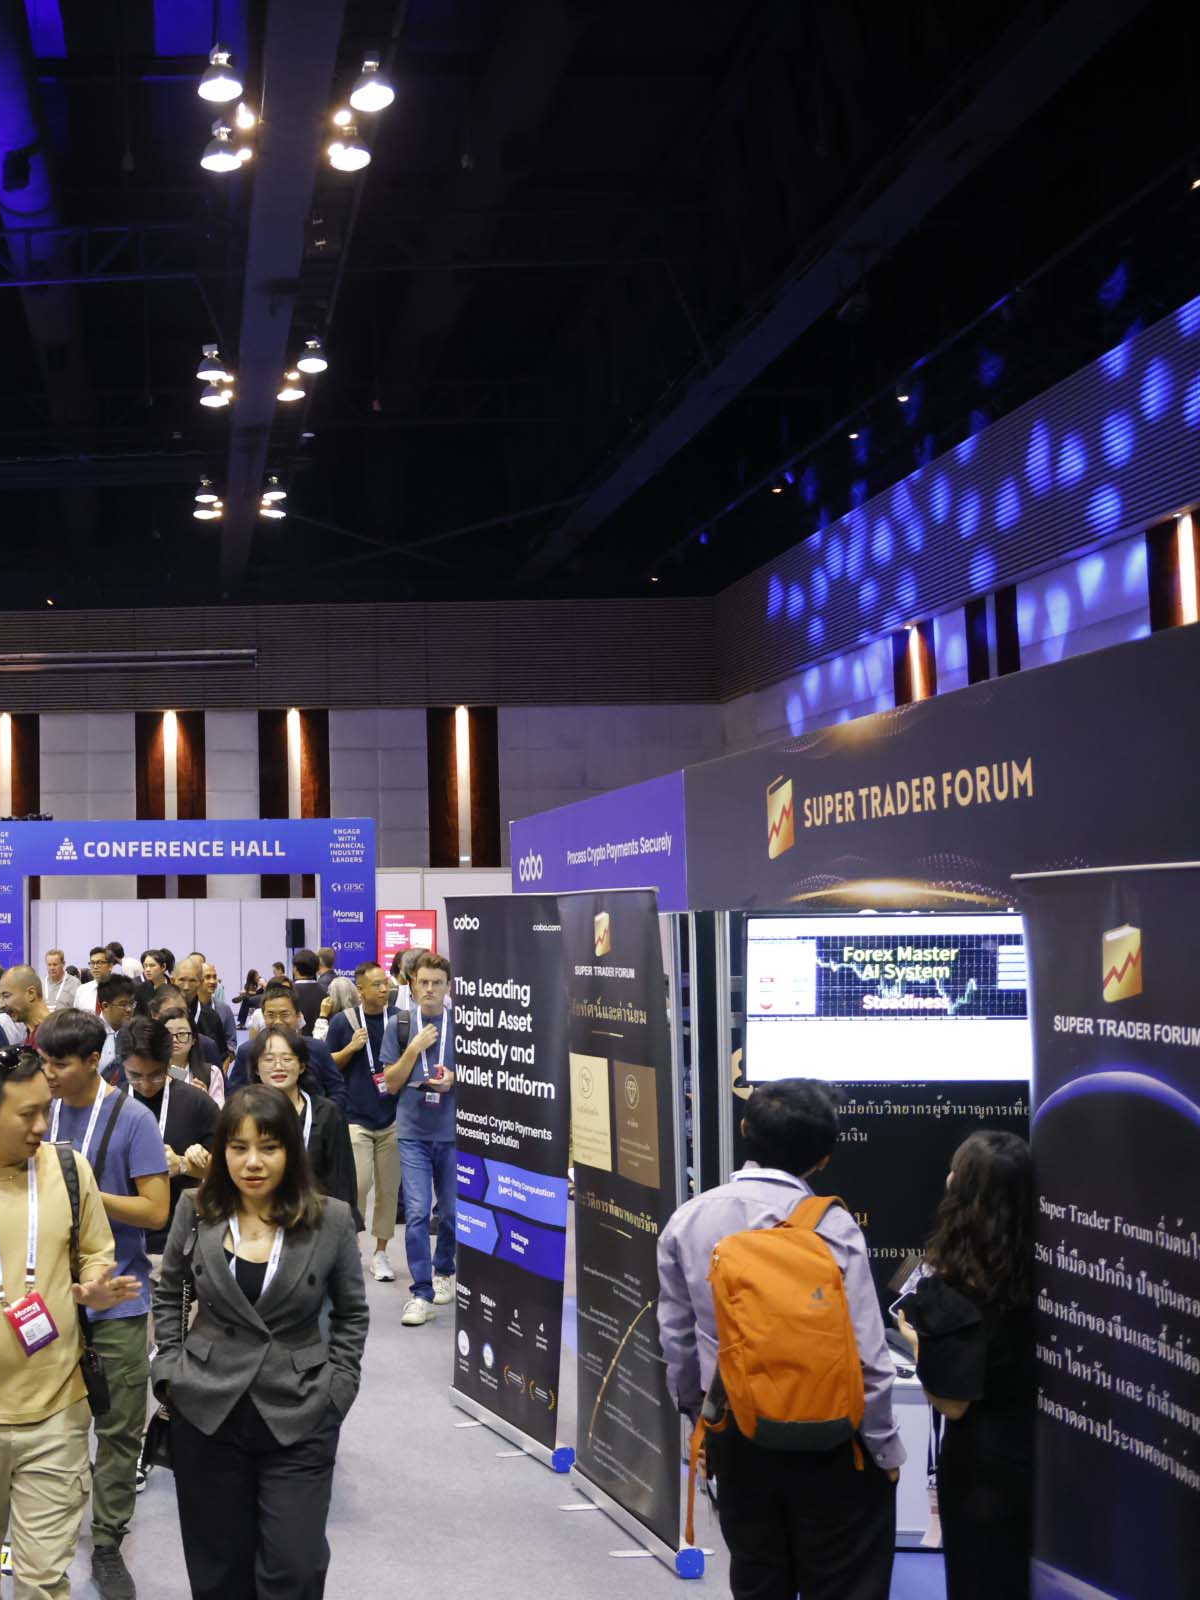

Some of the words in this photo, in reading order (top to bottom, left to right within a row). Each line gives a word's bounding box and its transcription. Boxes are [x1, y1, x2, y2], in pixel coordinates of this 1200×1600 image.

[803, 791, 856, 828] SUPER
[858, 776, 937, 820] TRADER
[942, 757, 1033, 808] FORUM
[83, 840, 224, 857] CONFERENCE
[231, 840, 286, 857] HALL
[567, 850, 587, 865] Process
[586, 846, 606, 867] Crypto
[606, 839, 639, 864] Payments
[639, 831, 673, 856] Securely
[519, 848, 543, 882] cobo
[333, 910, 360, 919] Money
[453, 914, 480, 931] cobo
[843, 945, 895, 962] Forex
[897, 945, 960, 962] Master
[334, 968, 355, 976] Mone
[862, 964, 881, 979] AI
[886, 964, 950, 981] System
[454, 976, 476, 996] The
[479, 978, 531, 1008] Leading
[454, 1005, 494, 1031] Digital
[498, 1010, 533, 1033] Asset
[1054, 1015, 1094, 1035] SUPER
[1097, 1019, 1151, 1041] TRADER
[1154, 1024, 1200, 1047] FORUM
[455, 1035, 508, 1066] Custody
[510, 1044, 535, 1065] and
[456, 1064, 493, 1088] Wallet
[497, 1070, 555, 1100] Platform
[456, 1108, 488, 1126] Advanced
[488, 1116, 515, 1132] Crypto
[515, 1122, 552, 1140] Payments
[456, 1124, 490, 1145] Processing
[491, 1133, 520, 1149] Solution
[1039, 1195, 1066, 1220] Super
[1068, 1205, 1111, 1231] Trader
[1114, 1216, 1153, 1244] Forum
[1035, 1242, 1052, 1265] 2561
